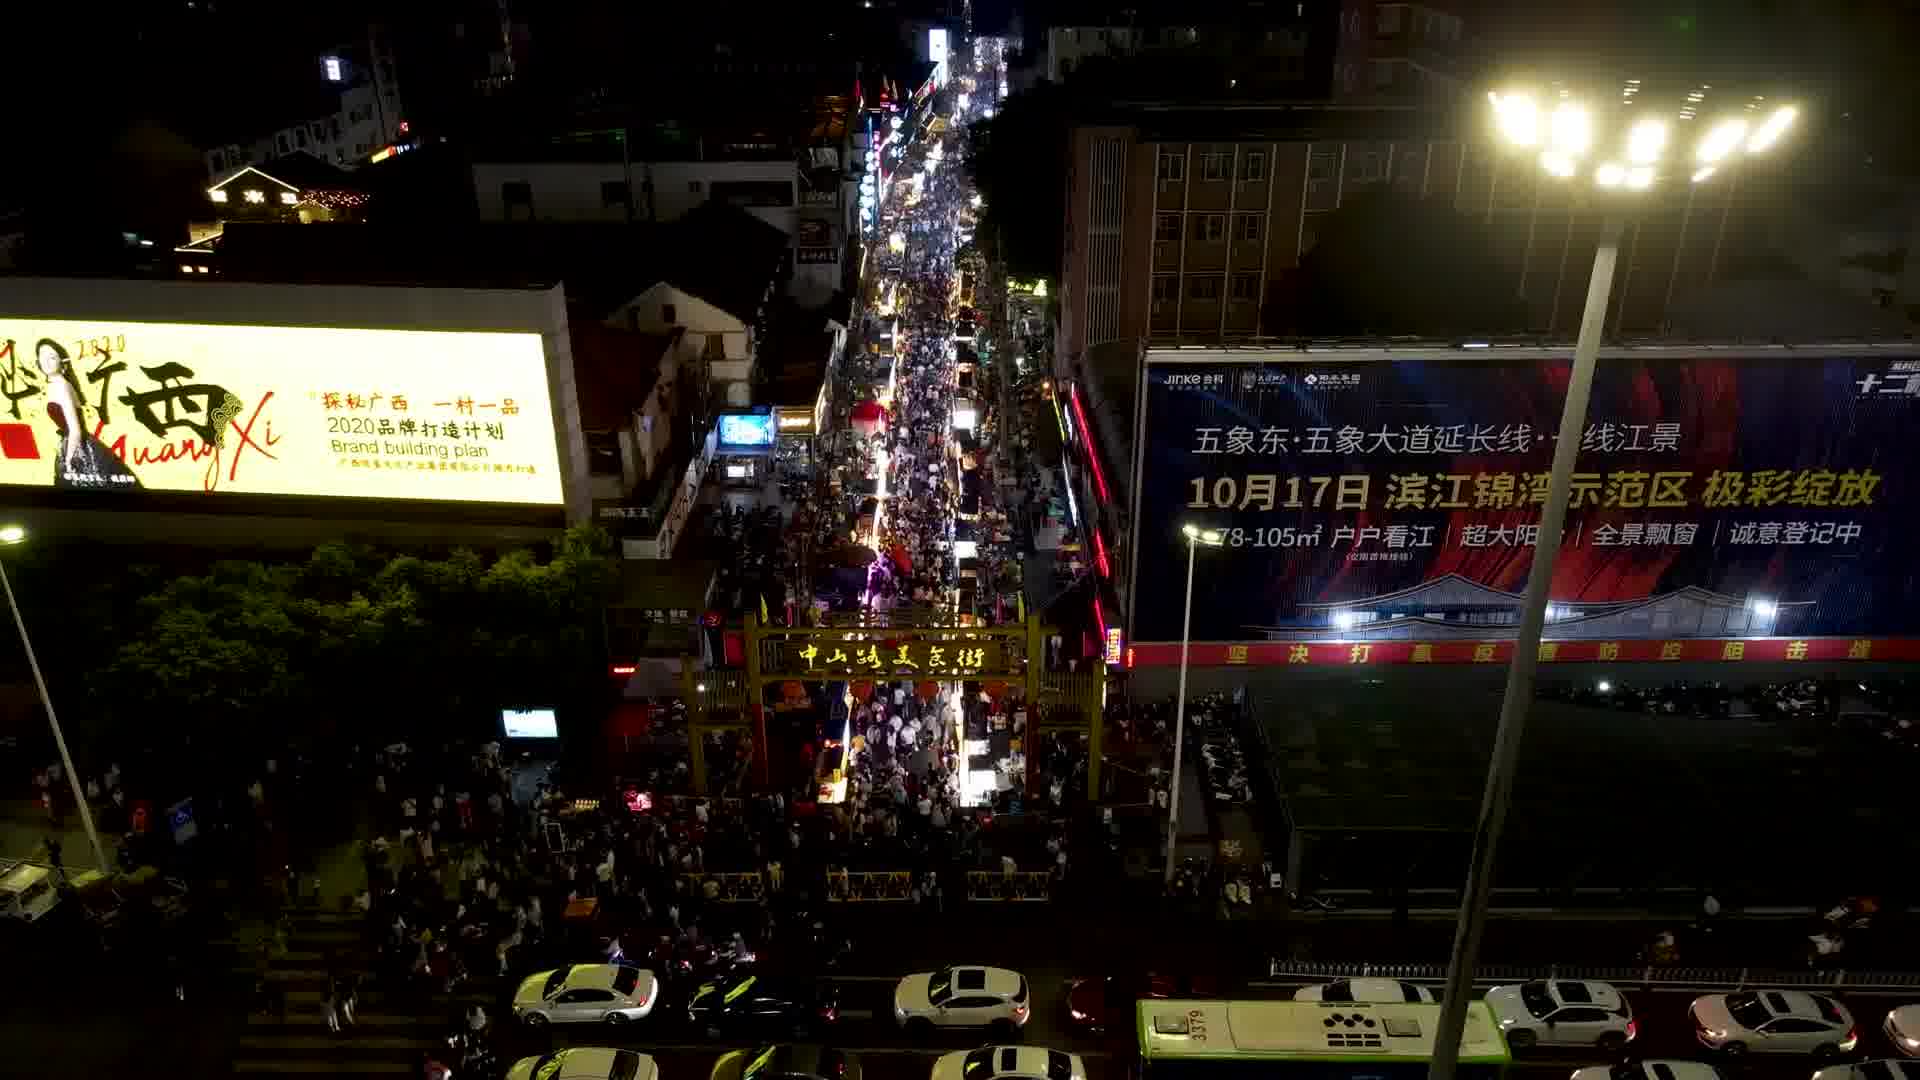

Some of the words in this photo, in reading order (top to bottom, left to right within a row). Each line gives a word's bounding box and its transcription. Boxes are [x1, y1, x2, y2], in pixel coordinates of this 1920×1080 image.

[322, 391, 409, 412] 探秘广西
[432, 395, 521, 416] 一村一品
[231, 391, 281, 481] Xi
[327, 416, 505, 441] 2020品牌打造计划
[331, 439, 380, 456] Brand
[385, 440, 449, 460] building
[454, 444, 489, 459] plan
[1187, 474, 1371, 512] 10月17日
[1703, 469, 1882, 508] 极彩绽放
[1330, 525, 1435, 549] 户户看江
[1461, 525, 1565, 548] 超大阳
[1591, 522, 1699, 546] 全景飘窗
[1729, 521, 1862, 545] 诚意登记中
[799, 645, 986, 669] 中山路美食街
[1189, 1009, 1209, 1042] 3379
